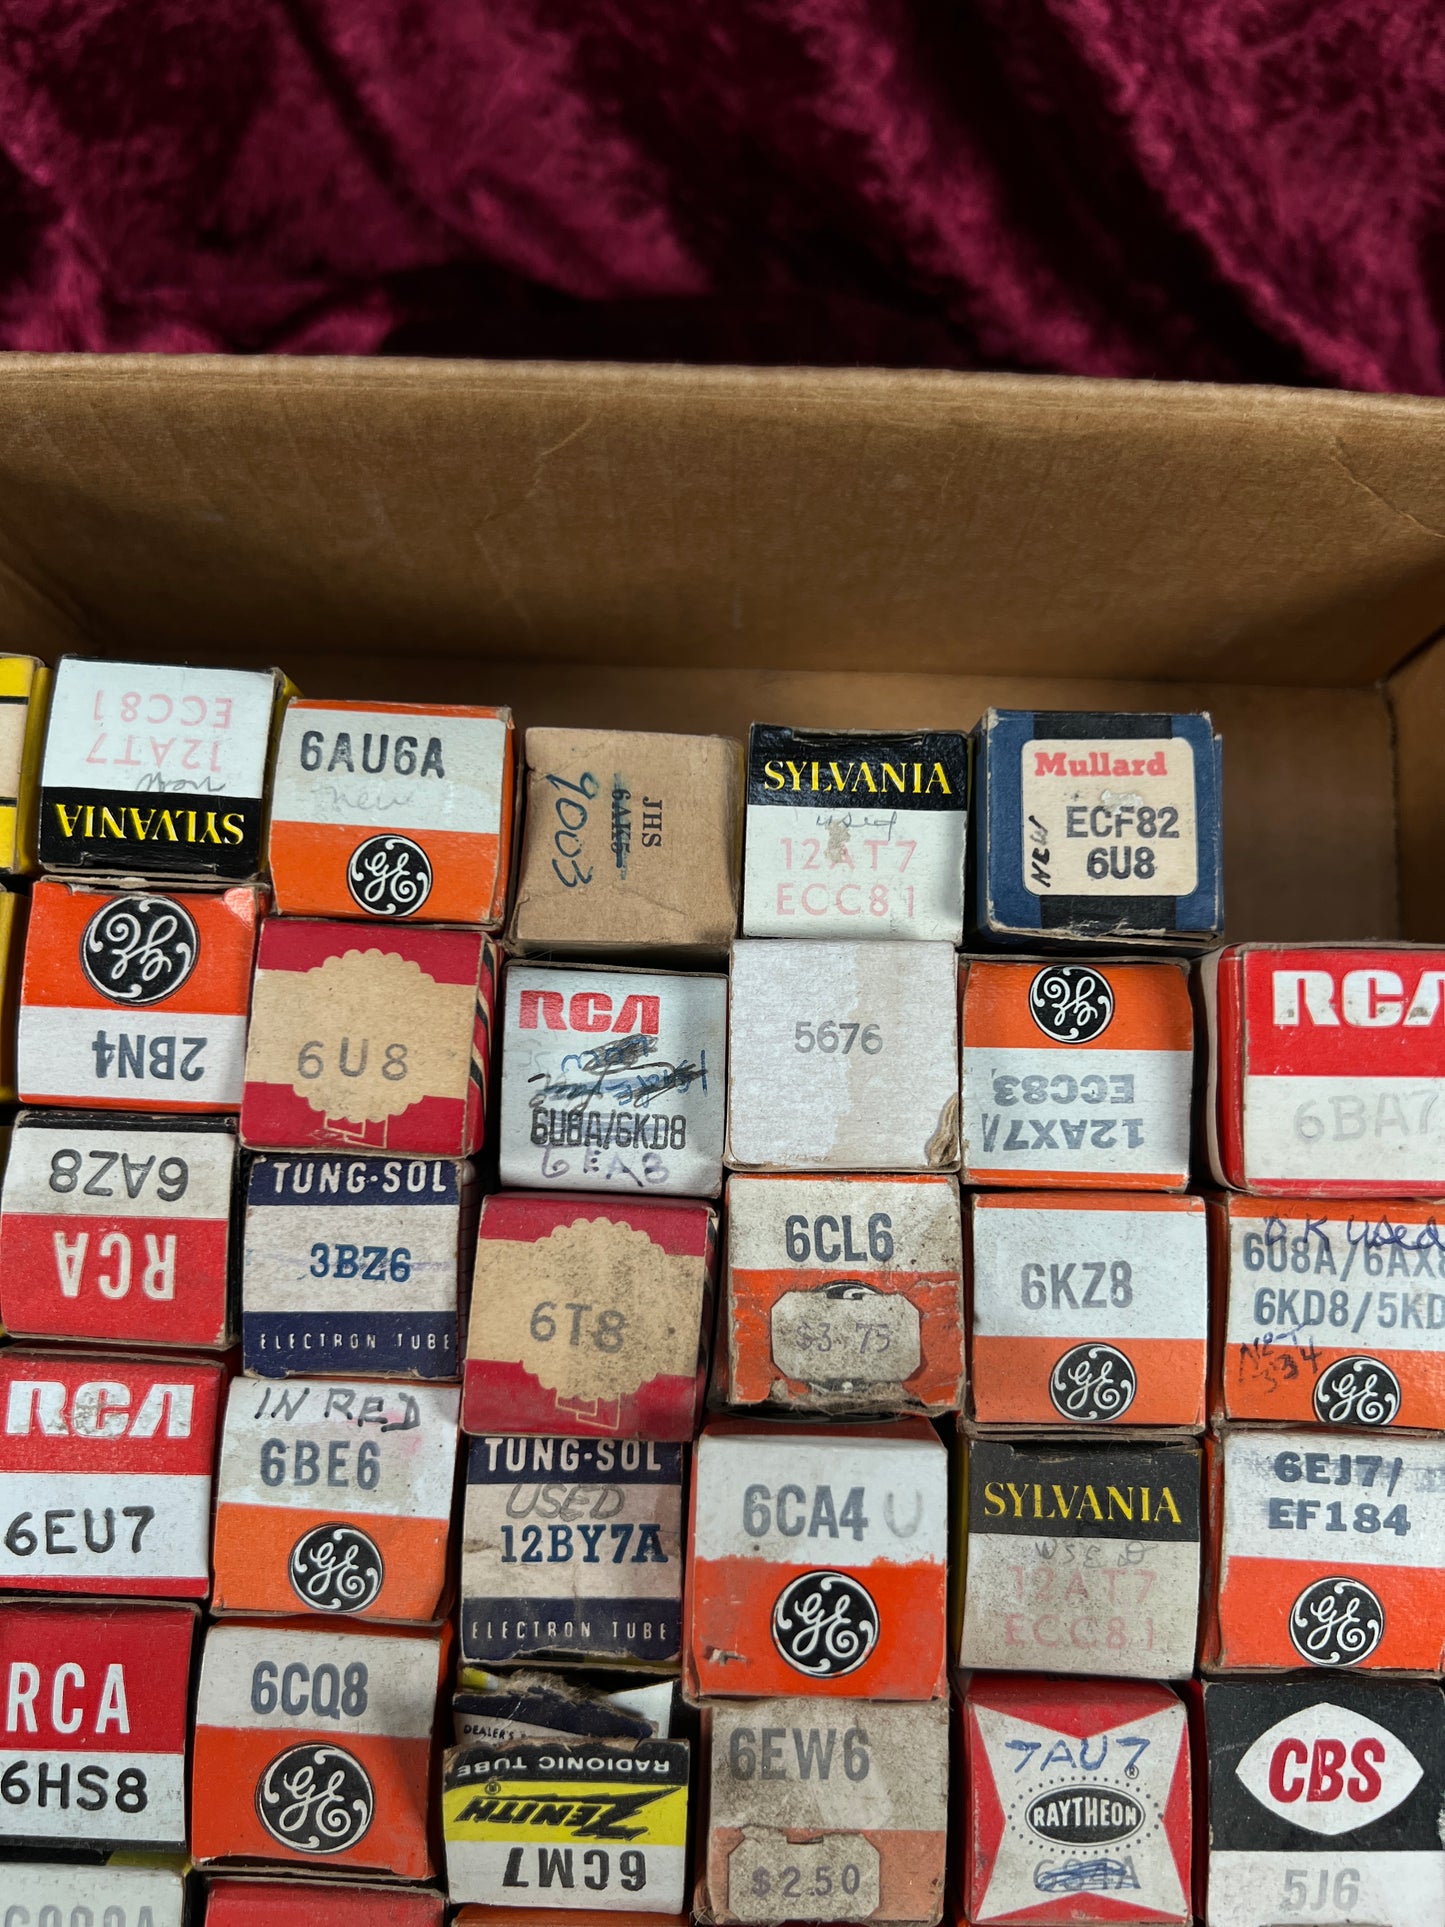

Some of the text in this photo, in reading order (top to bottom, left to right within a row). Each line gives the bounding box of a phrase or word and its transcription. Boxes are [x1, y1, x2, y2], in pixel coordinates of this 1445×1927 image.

[93, 690, 234, 729] ECC81
[86, 732, 222, 773] 12AT7
[301, 730, 445, 778] 6AU6A
[1034, 752, 1168, 777] Mullard
[764, 759, 952, 795] SYLVANIA
[56, 803, 245, 845] SYLVANIA
[547, 770, 598, 888] 9003
[641, 796, 663, 848] JHS
[1066, 805, 1180, 840] ECF82
[780, 837, 918, 873] 12AT7
[1028, 815, 1052, 888] NEW
[1086, 846, 1157, 881] 6U8
[776, 882, 915, 918] ECC81
[518, 990, 660, 1035] RCA
[1272, 970, 1445, 1027] RCA
[92, 1029, 208, 1082] 2BN4
[297, 1037, 409, 1080] 6U8
[794, 1020, 884, 1056] 5676
[992, 1073, 1135, 1106] ECC83
[1294, 1089, 1440, 1143] 6BA7
[50, 1148, 189, 1202] 6AZ8
[273, 1161, 447, 1194] TUNG-SOL
[785, 1213, 895, 1262] 6CL6
[53, 1231, 176, 1300] RCA
[310, 1242, 412, 1283] 3BZ6
[1020, 1260, 1134, 1311] 6KZ8
[260, 1333, 450, 1350] ELECTRON TUBE
[530, 1301, 627, 1354] 6T8
[6, 1380, 195, 1438] RCA
[254, 1387, 421, 1433] IN RED
[260, 1437, 381, 1490] 6BE6
[484, 1438, 661, 1471] TUNG-SOL
[505, 1484, 625, 1520] USED
[742, 1483, 869, 1541] 6CA4
[984, 1481, 1182, 1523] SYLVANIA
[1268, 1497, 1411, 1537] EF184
[5, 1505, 155, 1556] 6EU7
[501, 1523, 668, 1563] 12BY7A
[1007, 1565, 1157, 1604] 12AT7
[472, 1621, 668, 1640] ELECTRON TUBE
[1005, 1613, 1154, 1650] ECC81
[6, 1662, 130, 1734] RCA
[250, 1661, 369, 1720] 6CQ8
[463, 1724, 515, 1740] DEALER'S
[456, 1756, 670, 1777] RADIONIC TUBE
[729, 1727, 871, 1782] 6EW6
[1005, 1735, 1151, 1774] 7AU7
[1268, 1737, 1386, 1803] CBS
[1, 1759, 148, 1814] 6HS8
[453, 1786, 682, 1841] ZENITH
[1033, 1797, 1137, 1827] RAYTHEON
[502, 1847, 647, 1893] 6CM7
[1284, 1867, 1361, 1912] 5J6
